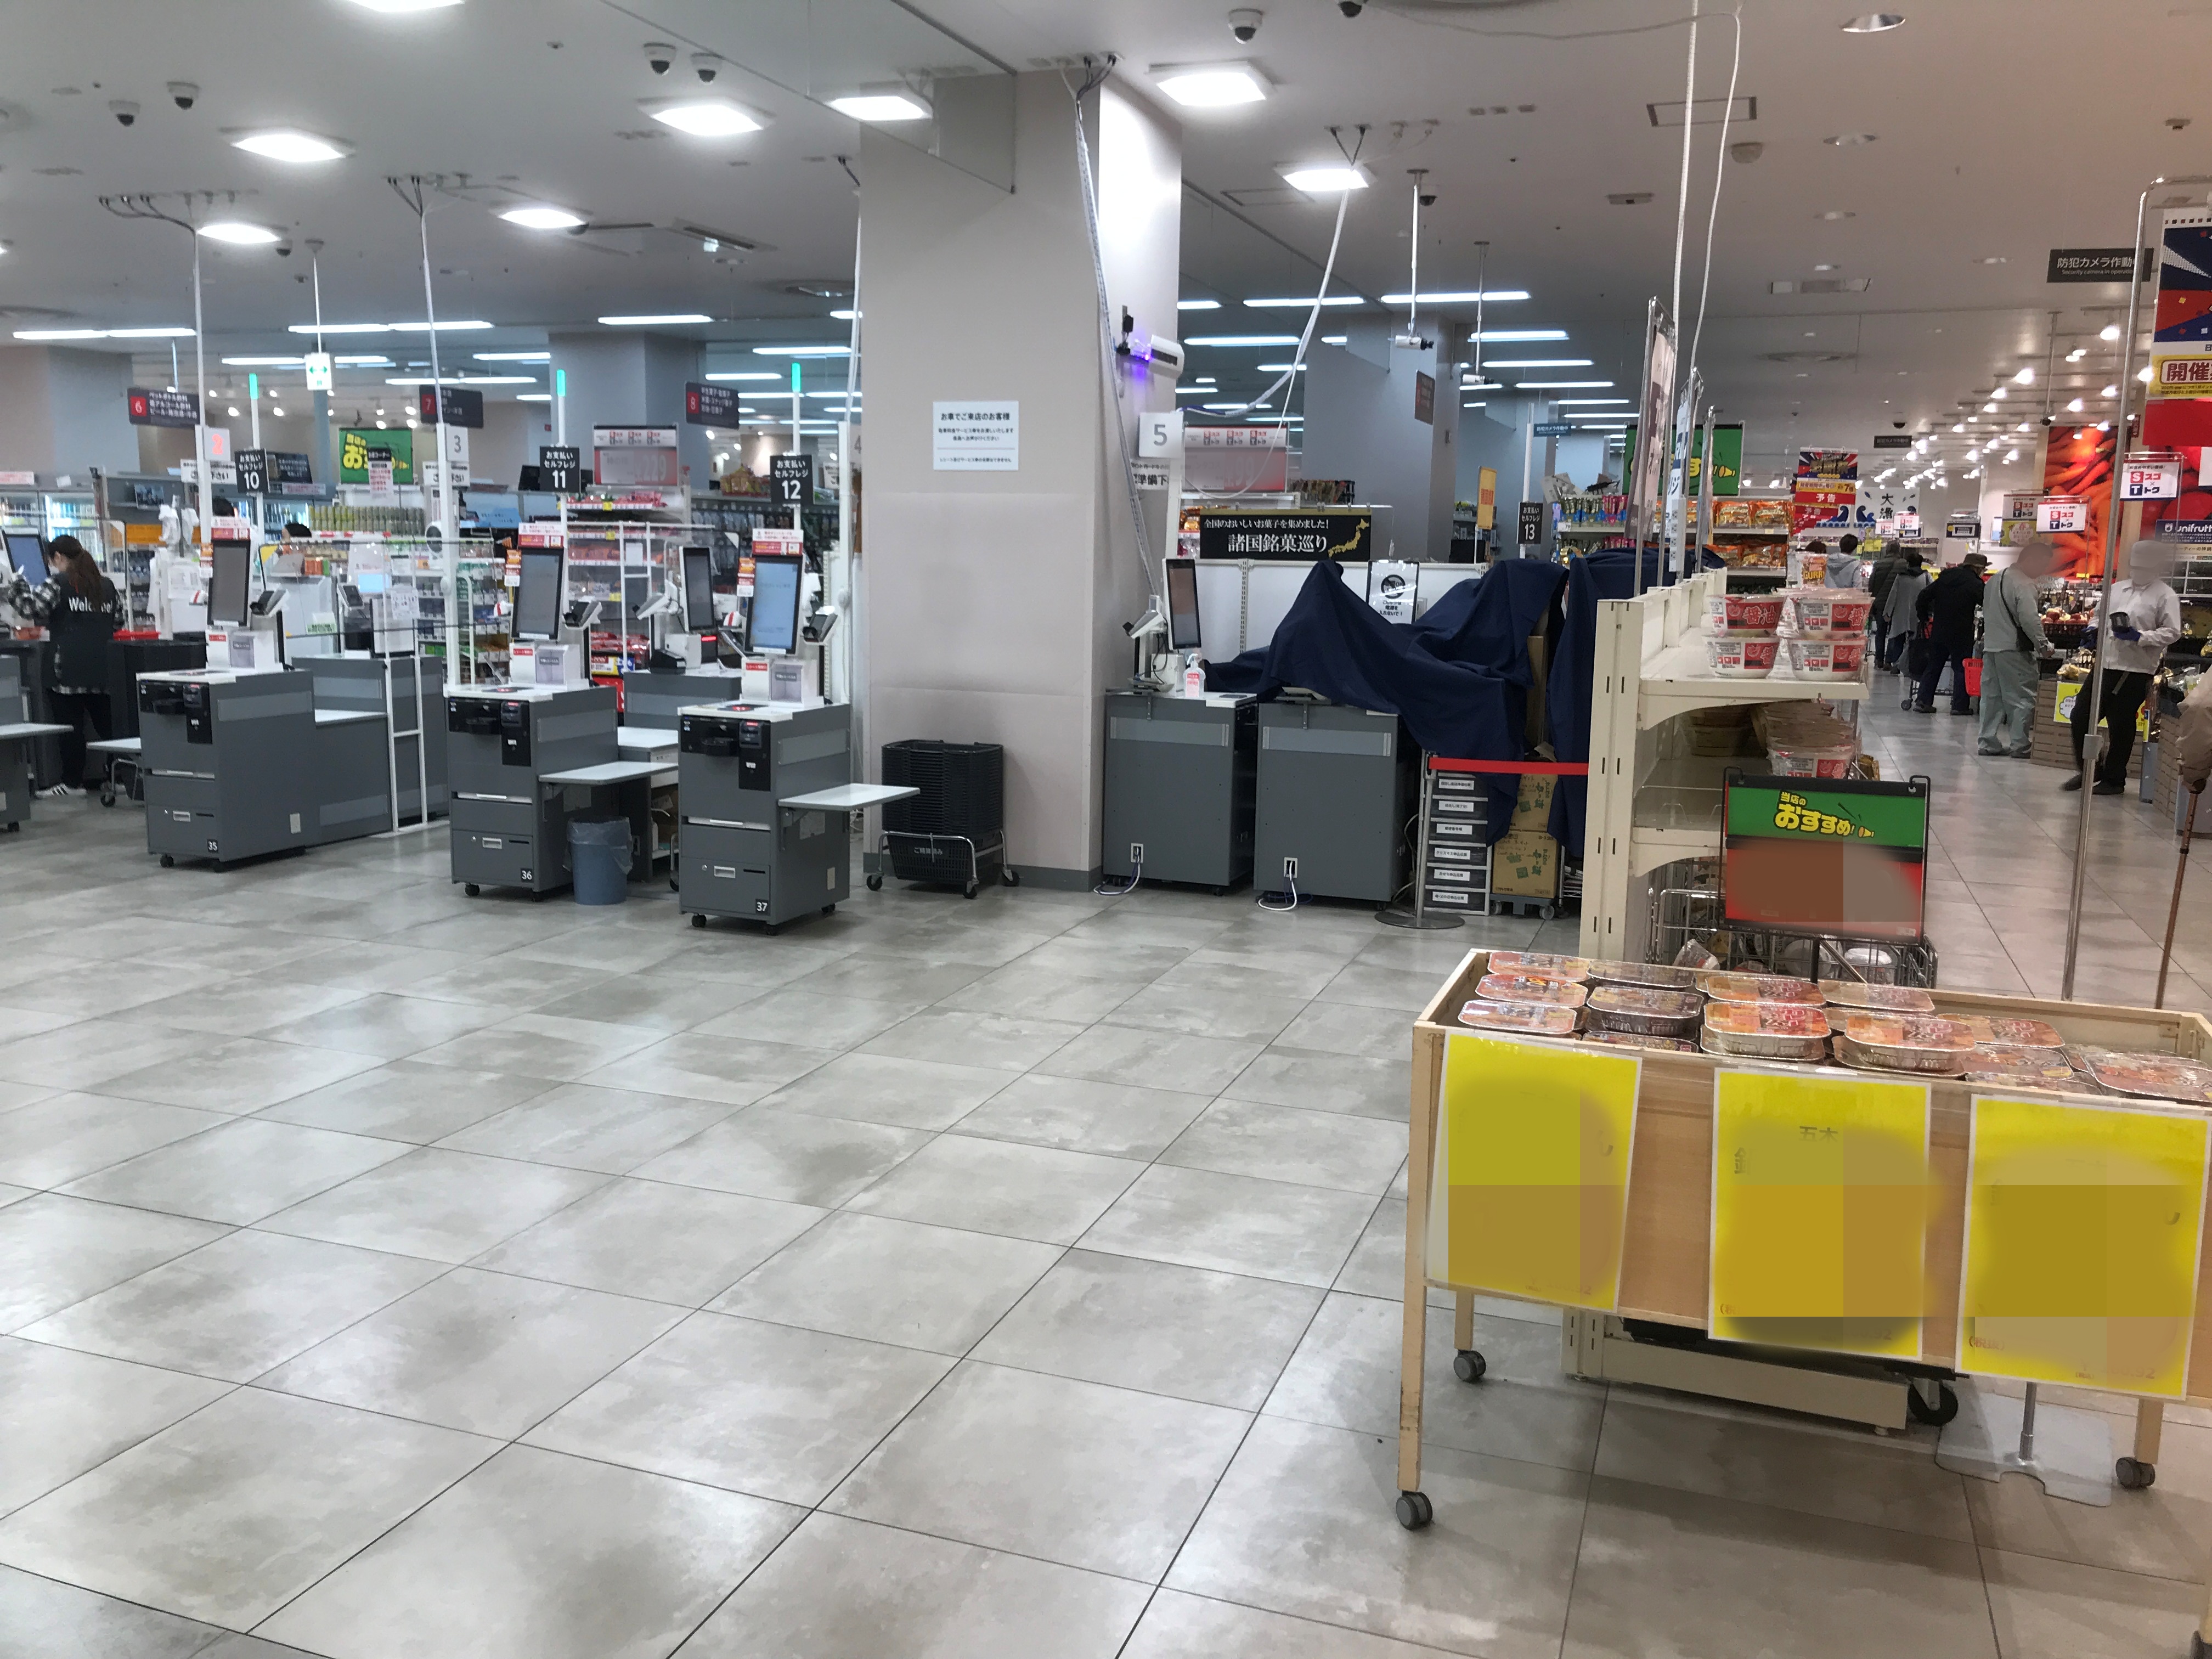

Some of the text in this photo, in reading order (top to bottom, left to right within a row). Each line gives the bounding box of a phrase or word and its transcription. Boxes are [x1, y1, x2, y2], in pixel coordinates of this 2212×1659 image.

[135, 400, 142, 414] 6
[690, 396, 696, 410] 8
[940, 413, 1010, 421] お車でご来店のお客様
[1153, 424, 1167, 447] 5
[211, 433, 224, 455] 2
[453, 435, 462, 453] 3
[546, 450, 573, 460] お支払い
[544, 460, 575, 469] セルフレジ
[776, 460, 806, 468] お支払い
[244, 471, 259, 490] 10
[552, 470, 566, 488] 11
[775, 469, 809, 478] セルフレジ
[781, 479, 801, 500] 12
[1816, 493, 1836, 503] 予告
[1204, 518, 1329, 530] 全国のおいしいお菓子を集めました!
[1524, 524, 1536, 540] 13
[1228, 534, 1327, 553] 諸国銘菓巡り
[1780, 792, 1807, 806] 当店の
[1775, 803, 1855, 836] おすすめ!
[208, 841, 218, 851] 35
[522, 870, 532, 880] 36
[757, 901, 768, 912] 37
